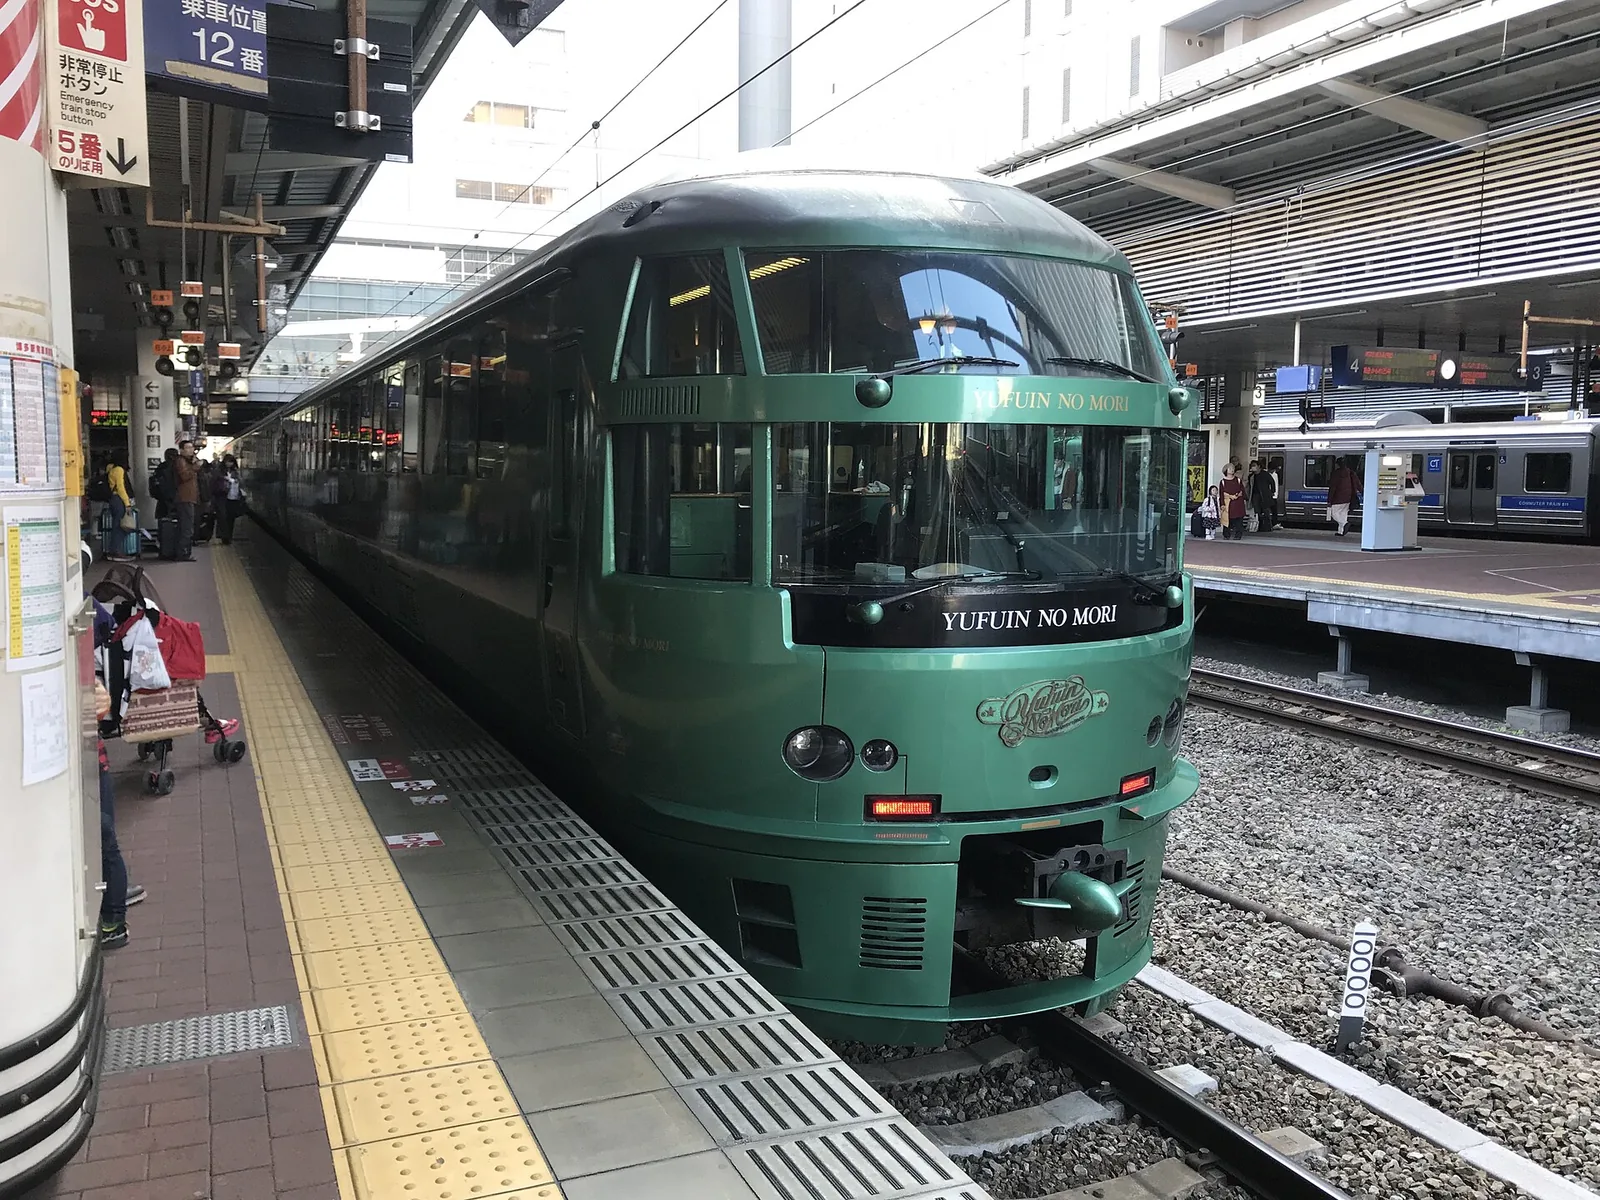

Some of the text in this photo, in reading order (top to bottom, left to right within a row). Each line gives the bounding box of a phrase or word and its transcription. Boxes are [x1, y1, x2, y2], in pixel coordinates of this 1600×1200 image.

[192, 28, 264, 73] 12番
[59, 54, 124, 84] 非常停止
[60, 73, 108, 95] ボタン
[60, 91, 114, 111] Emergency
[61, 102, 107, 119] train stop
[61, 111, 94, 126] button
[58, 129, 102, 161] 5番
[59, 156, 103, 175] のりば用
[1350, 358, 1360, 373] 4
[1532, 366, 1541, 380] 3
[974, 391, 1129, 412] YUFUIN NO MORI
[1255, 385, 1262, 399] 3
[942, 604, 1117, 632] YUFUIN NO MORI
